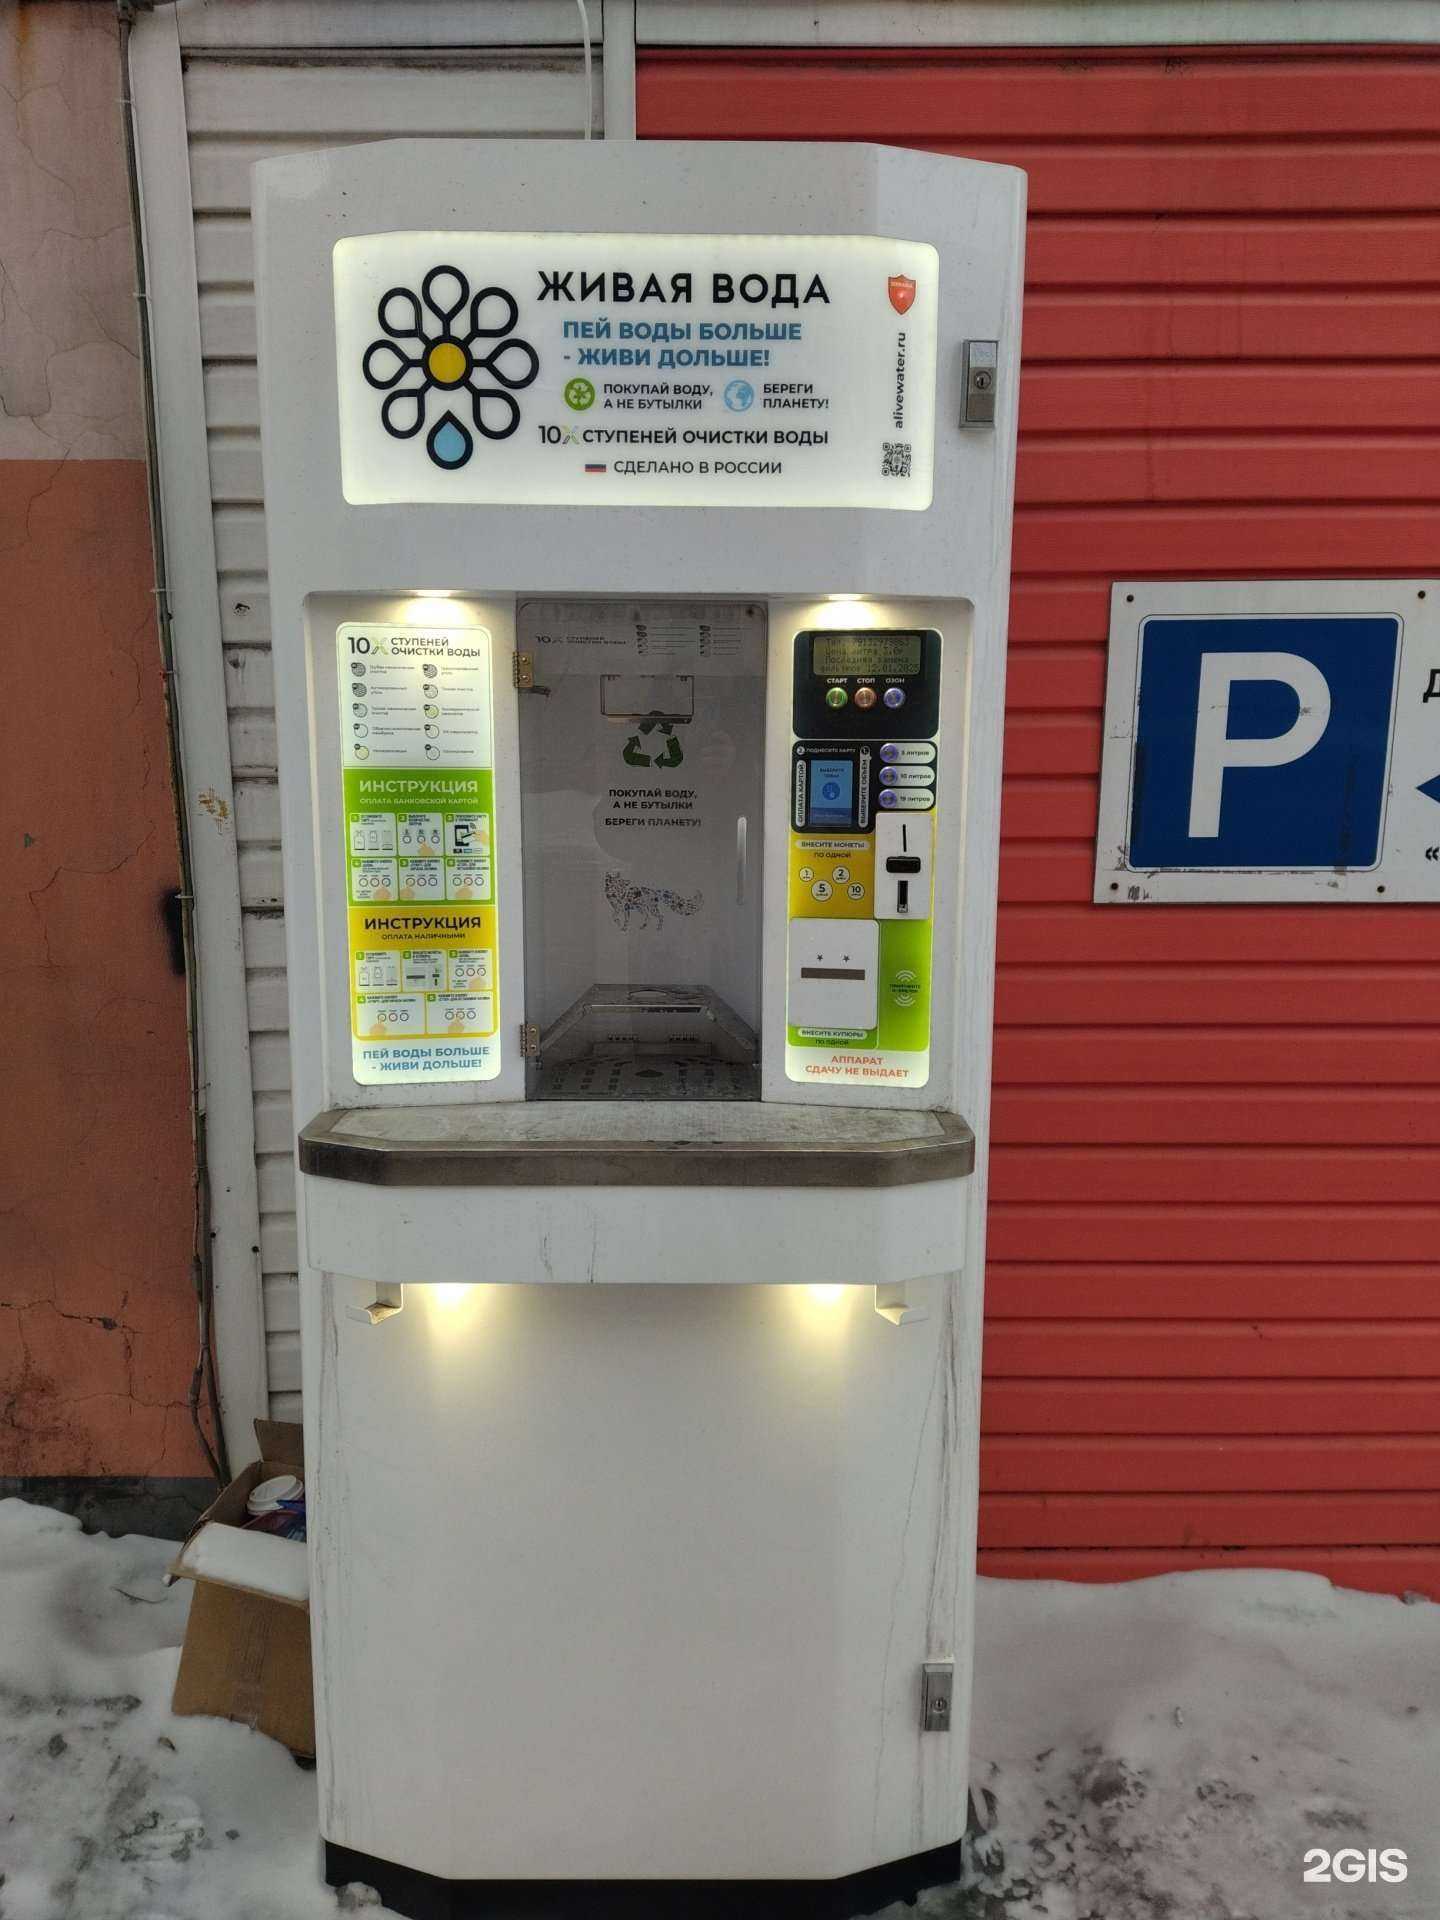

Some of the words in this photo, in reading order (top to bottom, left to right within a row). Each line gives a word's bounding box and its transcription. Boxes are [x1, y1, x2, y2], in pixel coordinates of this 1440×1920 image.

[537, 271, 692, 303] ЖИВАЯ
[712, 273, 831, 309] ВОДА
[563, 317, 611, 339] ПЕЙ
[619, 322, 691, 343] ВОДЫ
[700, 323, 802, 340] БОЛЬШЕ
[578, 348, 651, 366] ЖИВИ
[658, 349, 770, 369] ДОЛЬШЕ!
[892, 332, 906, 429] alivewater.ru
[604, 382, 669, 395] ПОКУПАЙ
[673, 384, 714, 396] ВОДУ,
[763, 384, 813, 394] БЕРЕГИ
[604, 399, 613, 409] А
[617, 399, 634, 409] НЕ
[638, 399, 702, 410] БУТЫЛКИ
[763, 399, 829, 409] ПЛАНЕТУ!
[582, 427, 677, 444] СТУПЕНЕЙ
[682, 430, 768, 444] ОЧИСТКИ
[774, 431, 829, 446] ВОДЫ
[614, 460, 694, 475] СДЕЛАНО
[699, 462, 709, 474] В
[715, 462, 782, 474] РОССИИ
[391, 637, 449, 647] СТУПЕНЕЙ
[391, 648, 444, 656] ОЧИСТКИ
[447, 648, 481, 657] ВОДЫ
[1188, 651, 1331, 838] P
[359, 780, 478, 794] ИНСТРУКЦИЯ
[608, 787, 662, 798] ПОКУПАЙ
[664, 789, 697, 799] ВОДУ,
[613, 801, 621, 809] А
[623, 801, 638, 809] НЕ
[640, 801, 693, 810] БУТЫЛКИ
[604, 818, 646, 826] БЕРЕГИ
[647, 818, 702, 827] ПЛАНЕТУ!
[837, 869, 845, 877] 2
[818, 883, 826, 893] 5
[851, 885, 862, 893] 10
[364, 916, 481, 931] ИНСТРУКЦИЯ
[414, 932, 466, 940] НАЛИЧНЫМИ
[363, 1049, 389, 1059] ПЕЙ
[392, 1048, 432, 1059] ВОДЫ
[435, 1046, 490, 1057] БОЛЬШЕ
[380, 1061, 419, 1071] ЖИВИ
[422, 1059, 483, 1071] ДОЛЬШЕ!
[831, 1055, 884, 1065] АППАРАТ
[805, 1065, 841, 1075] СДАЧУ
[845, 1067, 860, 1075] НЕ
[862, 1068, 909, 1078] ВЫДАЕТ
